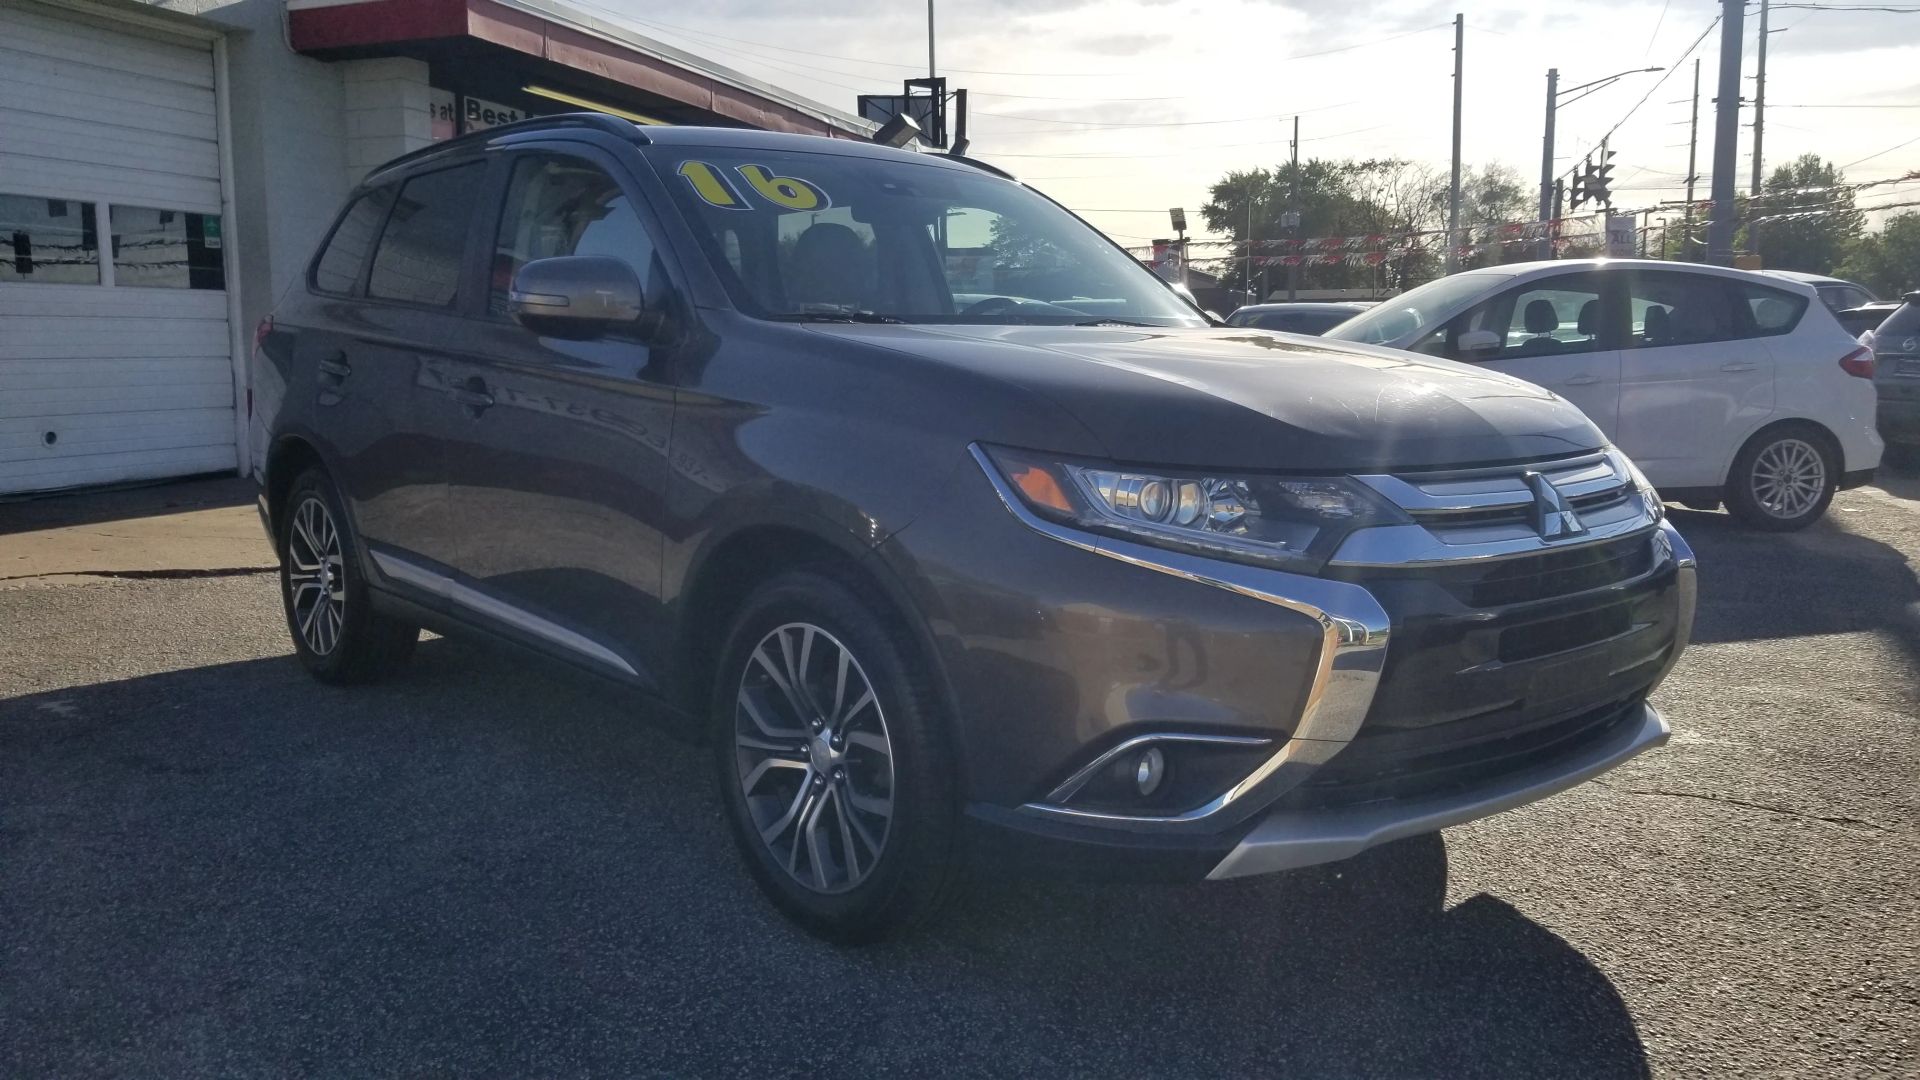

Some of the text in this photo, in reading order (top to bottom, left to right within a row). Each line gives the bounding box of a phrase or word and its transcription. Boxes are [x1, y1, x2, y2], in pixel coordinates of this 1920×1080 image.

[440, 103, 454, 121] at
[466, 98, 519, 125] Best
[677, 160, 832, 213] 16
